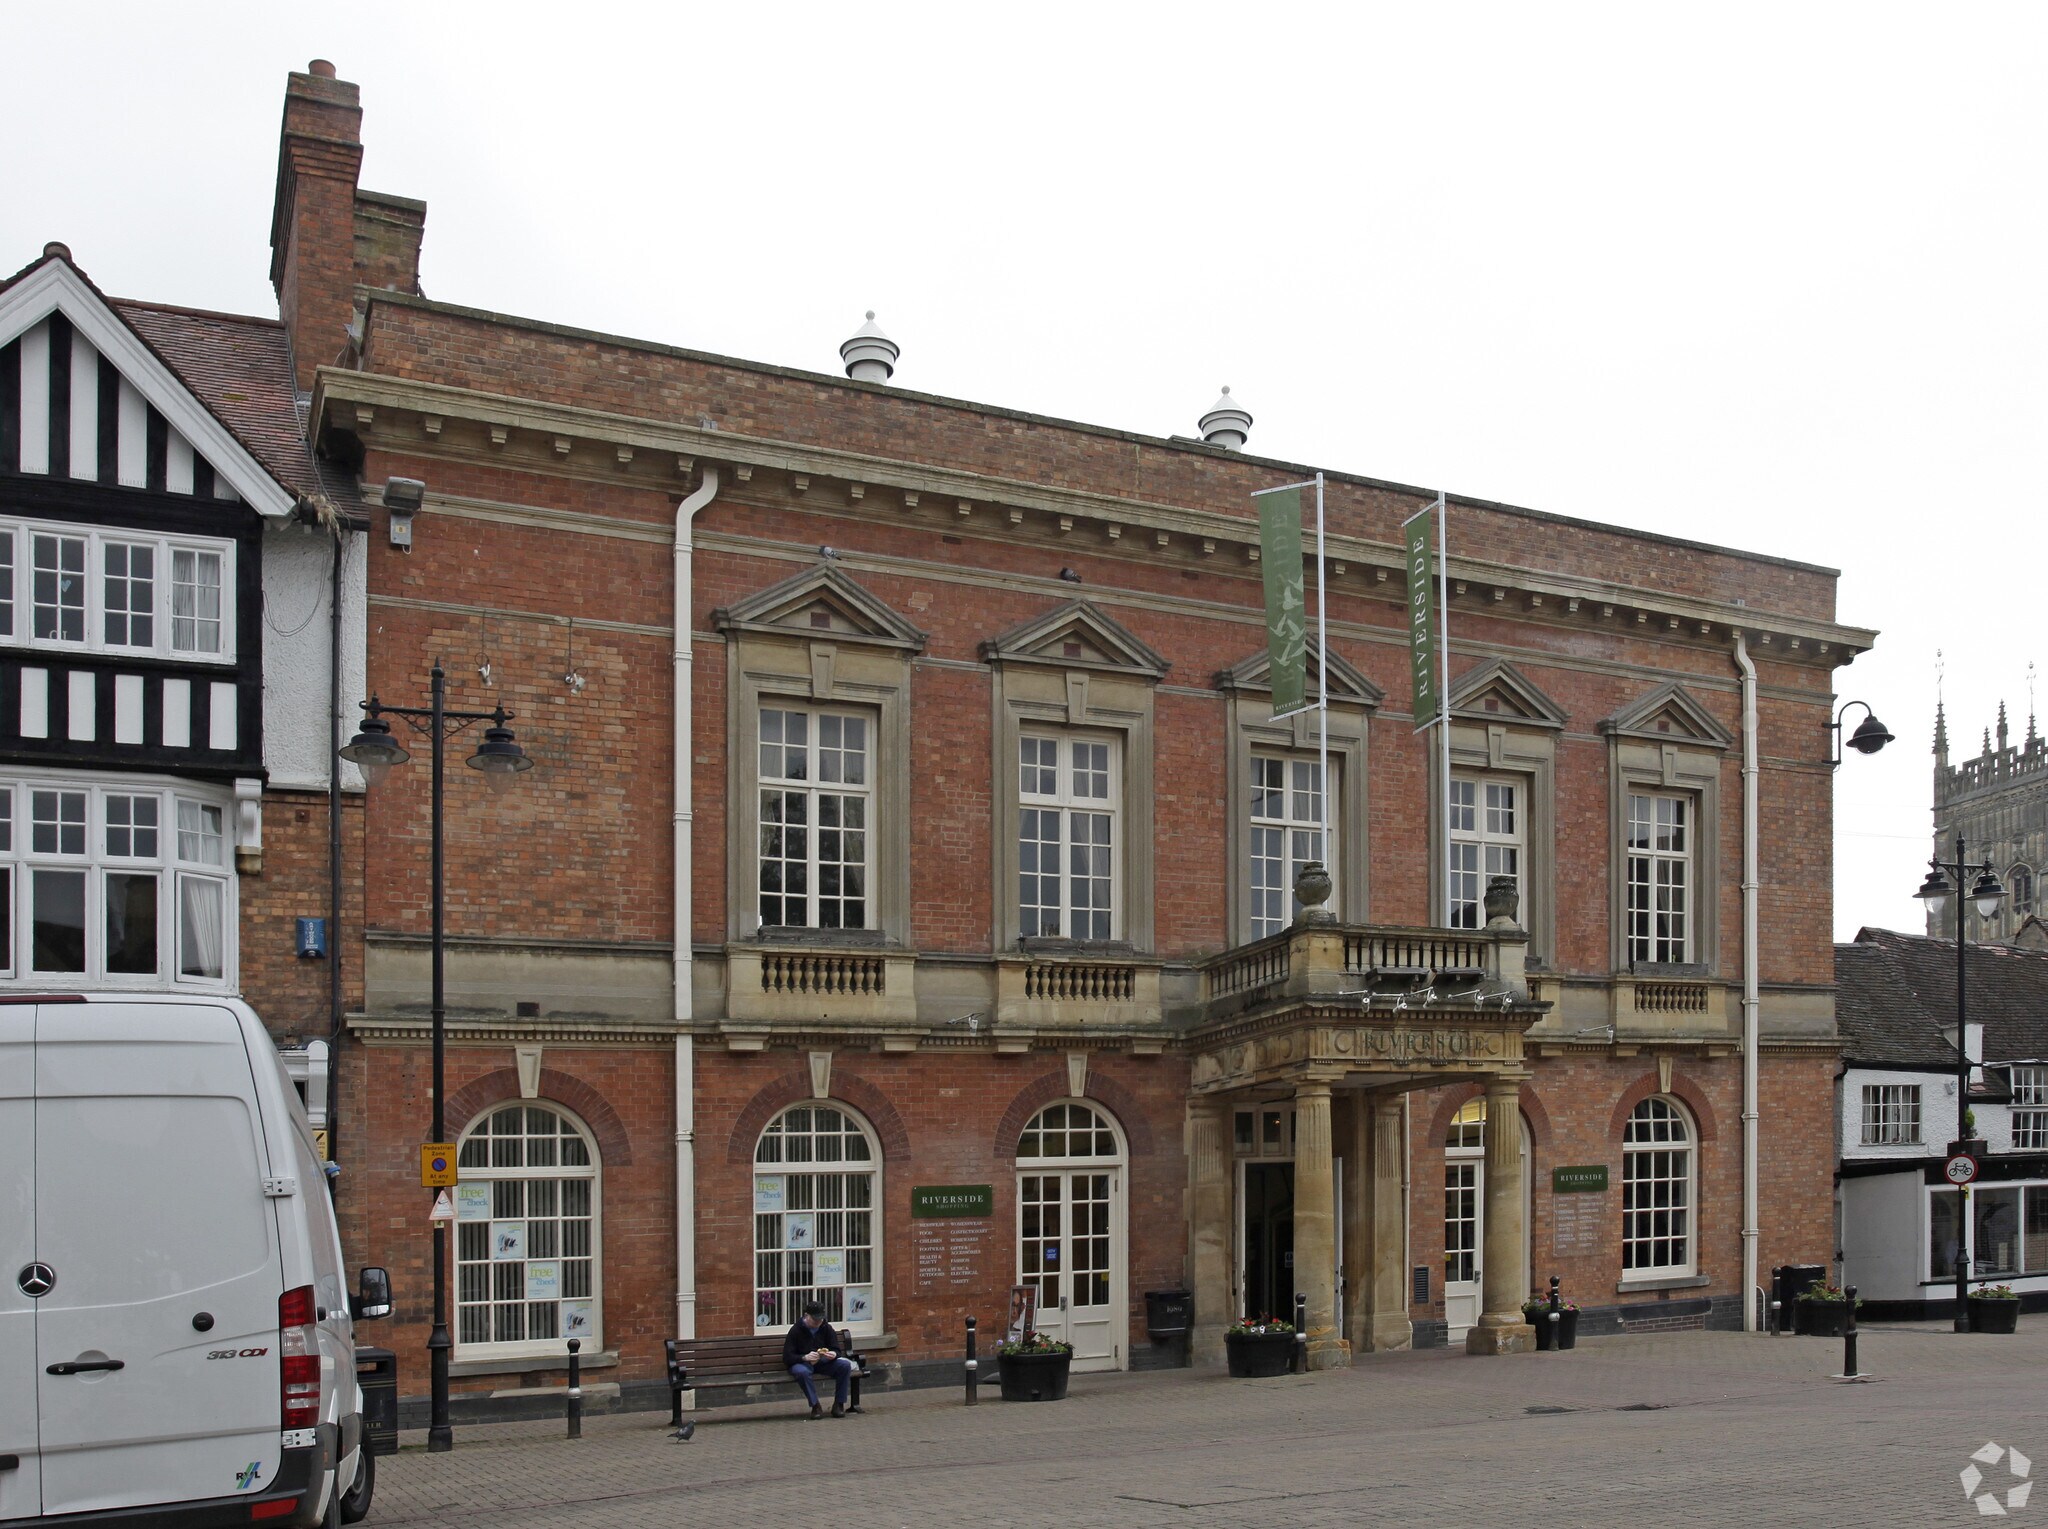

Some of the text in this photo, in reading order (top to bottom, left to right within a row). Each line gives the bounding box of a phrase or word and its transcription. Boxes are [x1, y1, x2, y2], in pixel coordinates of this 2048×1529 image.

[1413, 536, 1428, 698] RIVERSIDE
[1364, 1031, 1486, 1051] RIVERSIDE
[1560, 1173, 1603, 1182] RIVERSIDE
[758, 1179, 778, 1191] free
[460, 1186, 485, 1198] free
[921, 1194, 984, 1205] RIVERSIDE
[819, 1254, 839, 1265] free
[530, 1265, 553, 1278] free
[206, 1348, 268, 1360] 313 CDI
